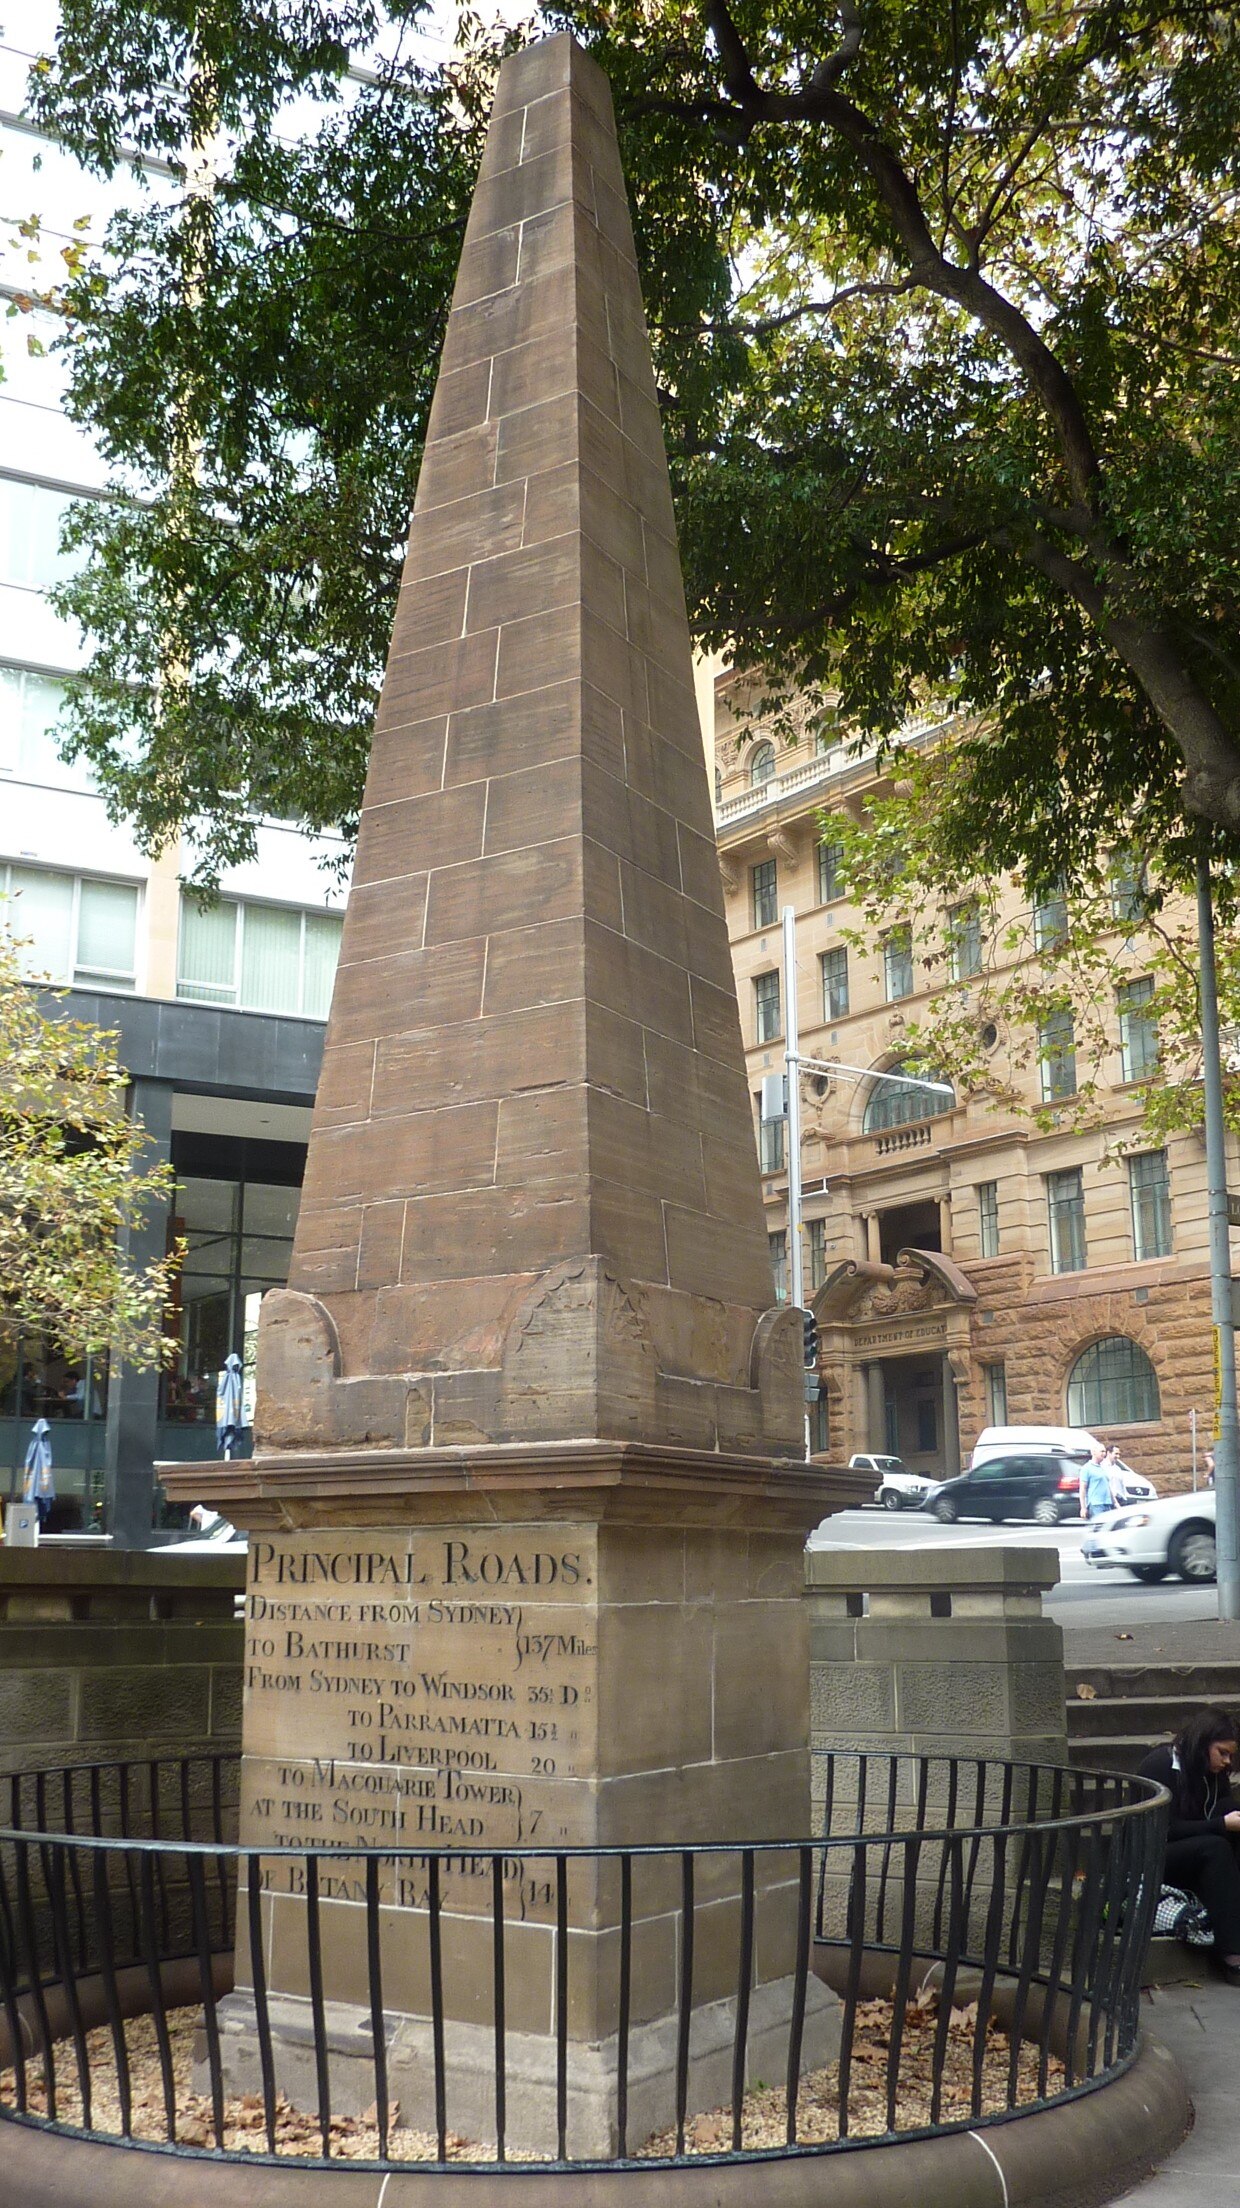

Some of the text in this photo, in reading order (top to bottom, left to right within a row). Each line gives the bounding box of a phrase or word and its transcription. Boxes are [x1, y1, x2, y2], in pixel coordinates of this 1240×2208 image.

[855, 1325, 945, 1347] DEPARTMENT OF EDUCAT
[250, 1541, 593, 1585] PRINCIPAL ROADS.
[248, 1594, 515, 1625] DISTANCE FROM SYDNEY
[247, 1630, 411, 1663] TO BATHURST
[247, 1666, 301, 1691] FROM
[310, 1668, 387, 1695] SYDNEY
[391, 1679, 417, 1697] TO
[418, 1671, 515, 1701] WINDSOR
[348, 1709, 373, 1728] TO
[379, 1702, 521, 1739] PARRAMATTA
[347, 1741, 373, 1761] TO
[379, 1734, 498, 1770] LIVERPOOL
[531, 1756, 556, 1775] 20
[278, 1757, 515, 1804] TO MACQUARIE TOWER
[250, 1798, 485, 1836] AT THE SOUTH HEAD
[529, 1809, 544, 1835] 7
[252, 1868, 277, 1891] F
[287, 1865, 386, 1905] BTAN
[527, 1880, 554, 1905] 14
